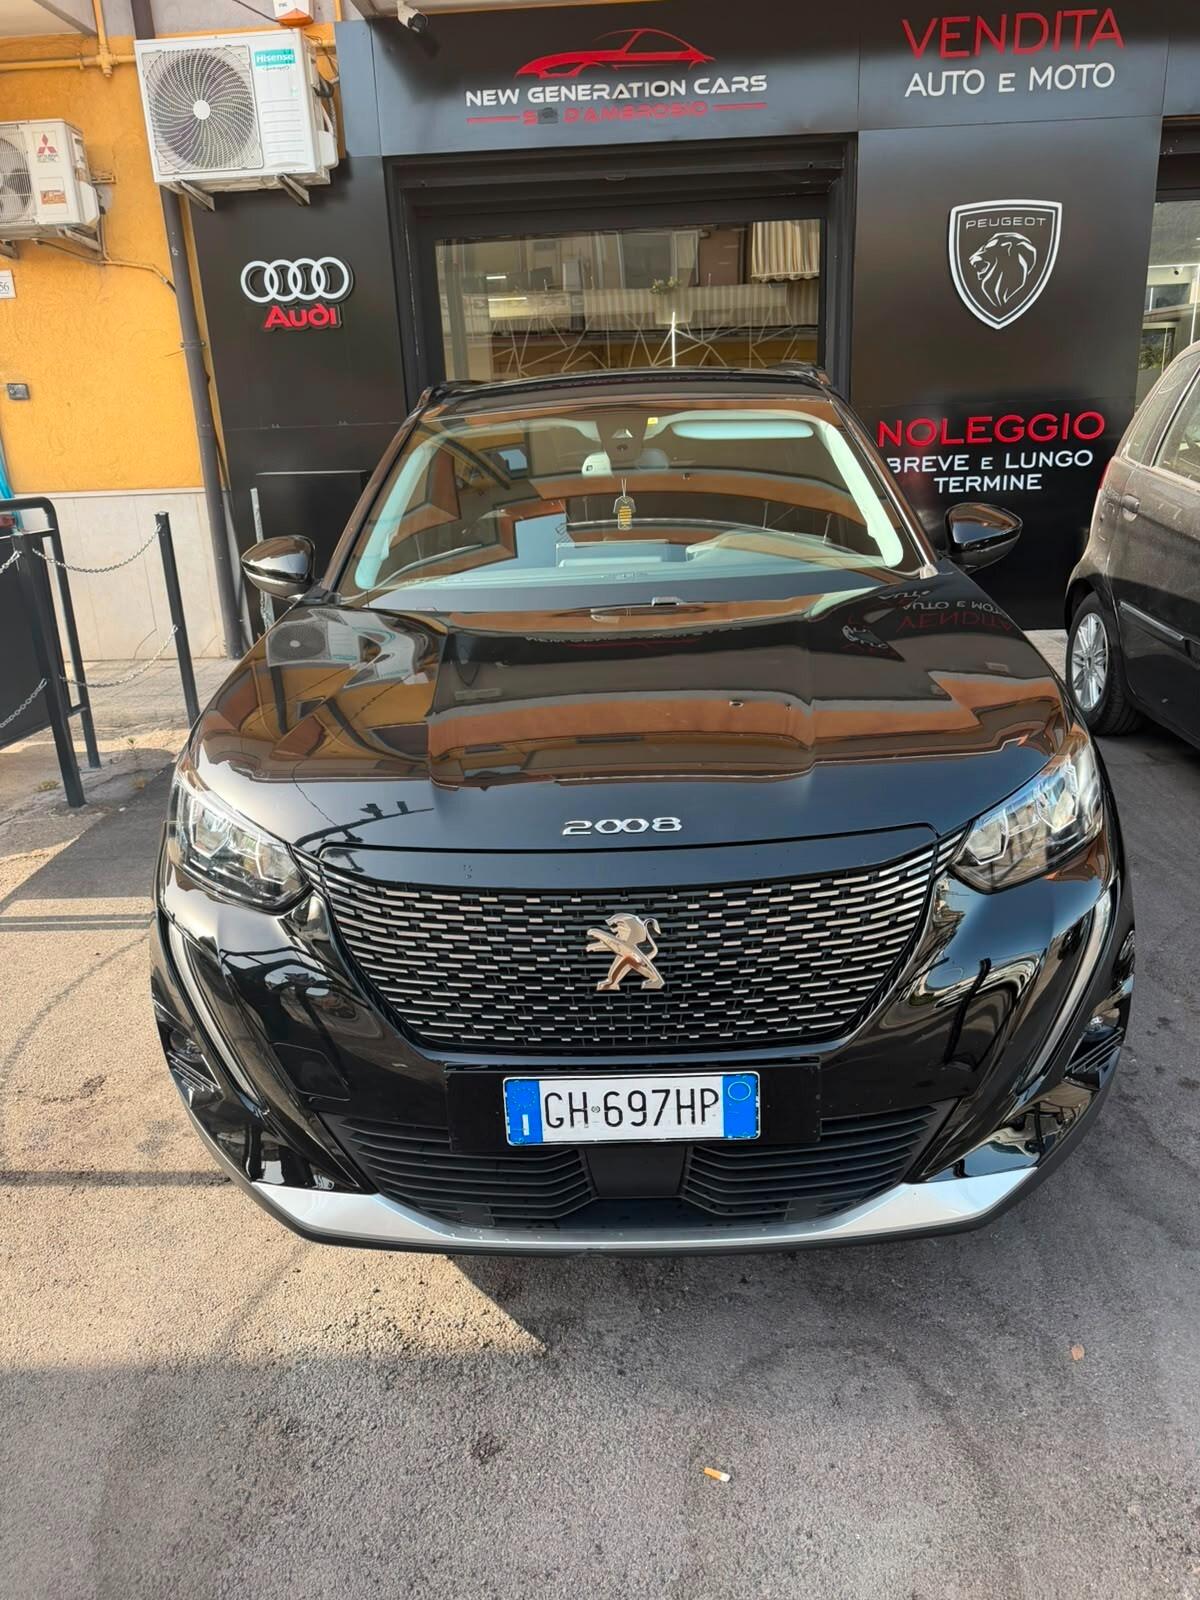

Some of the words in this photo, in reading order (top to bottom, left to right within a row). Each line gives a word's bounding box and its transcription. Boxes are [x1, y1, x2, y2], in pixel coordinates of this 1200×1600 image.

[902, 8, 1125, 60] VENDITA
[466, 88, 519, 107] NEW
[528, 79, 686, 104] GENERATION
[694, 74, 768, 95] CARS
[905, 69, 985, 97] AUTO
[999, 73, 1016, 93] E
[1029, 62, 1115, 91] MOTO
[965, 216, 1047, 230] PEUGEOT
[263, 303, 337, 329] Audi
[877, 411, 1105, 448] NOLEGGIO
[887, 453, 969, 474] BREVE
[981, 456, 993, 470] E
[1005, 449, 1093, 468] LUNGO
[933, 474, 1042, 494] TERMINE
[562, 816, 683, 836] 2008
